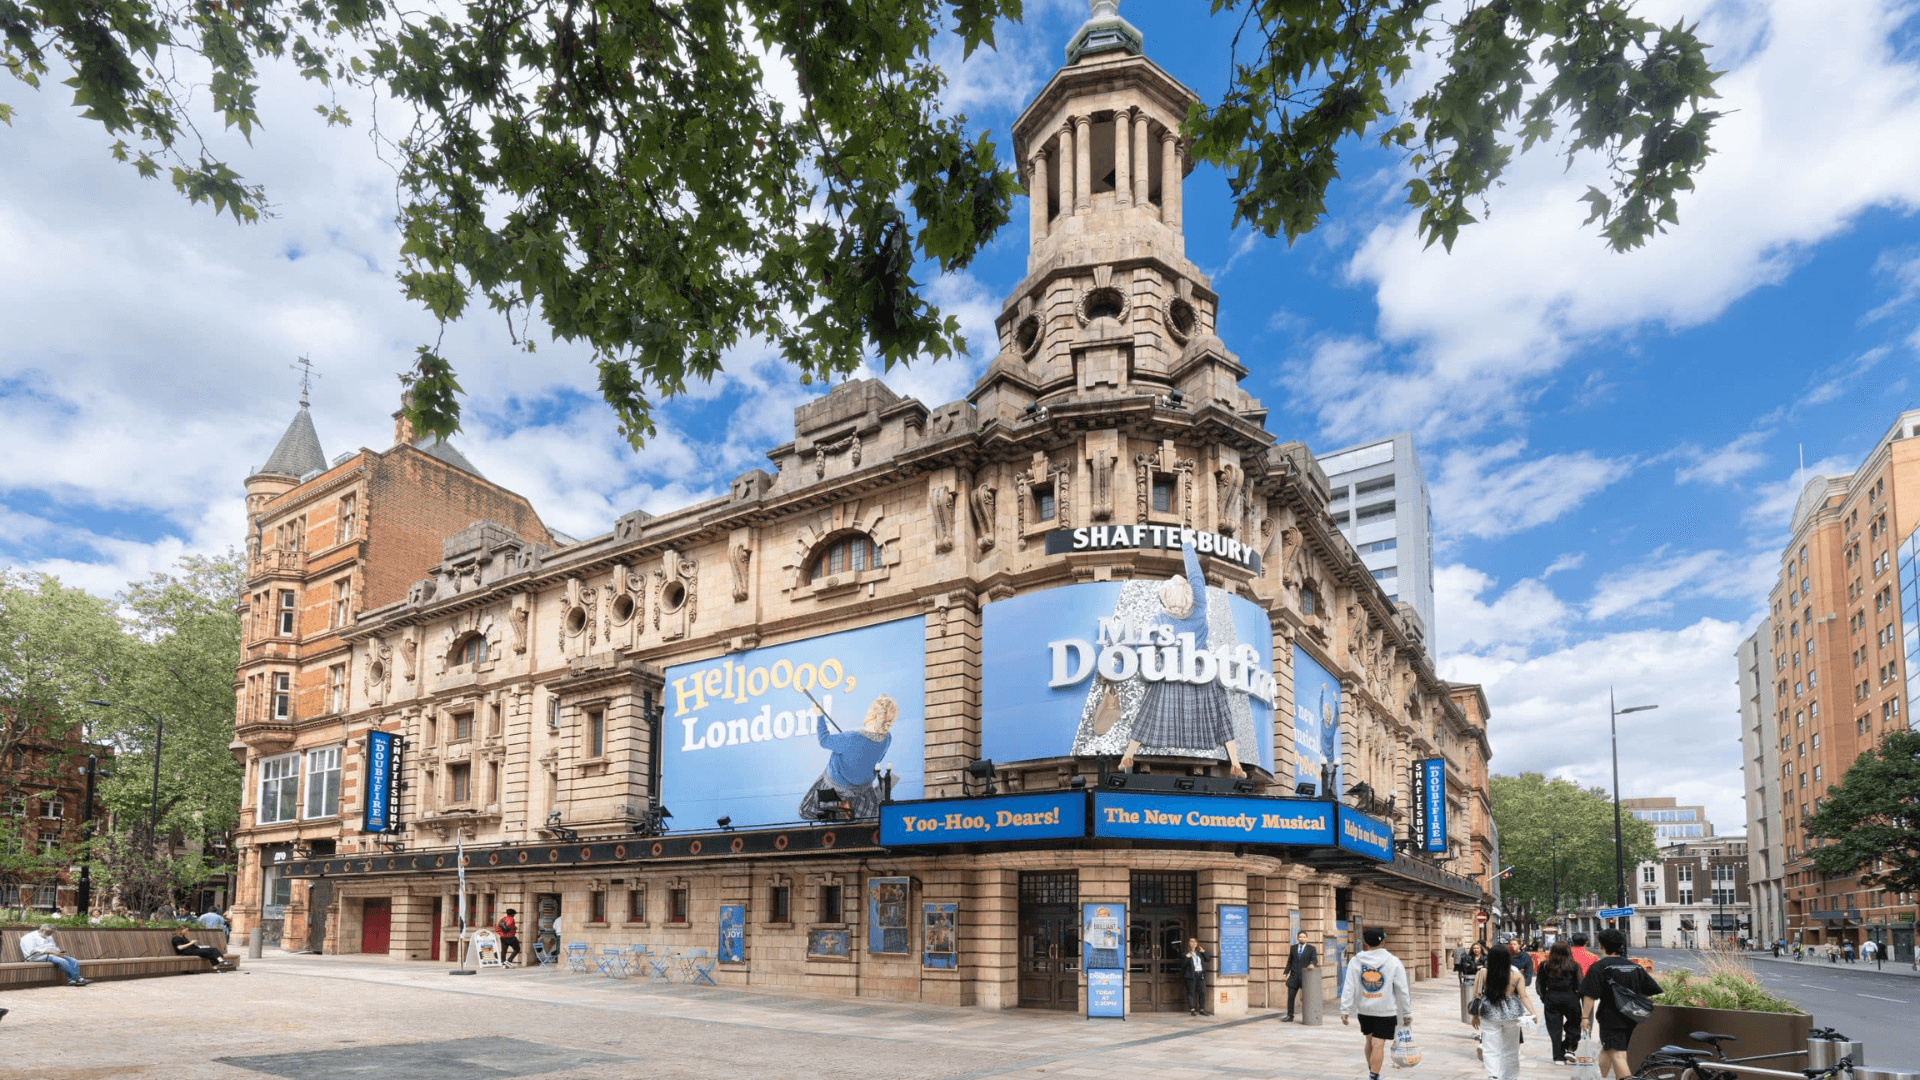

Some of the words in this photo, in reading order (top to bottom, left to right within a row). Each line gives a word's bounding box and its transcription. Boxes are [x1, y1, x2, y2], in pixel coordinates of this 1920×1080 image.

[1096, 617, 1182, 646] Mrs.
[672, 658, 857, 717] Helloooo,
[682, 694, 832, 752] London!
[1298, 704, 1315, 727] new
[372, 744, 385, 817] DOUBTFIRE
[390, 738, 401, 831] SHAFTESBURY
[903, 813, 991, 832] Yoo-Hoo,
[996, 807, 1060, 827] Dears!
[1104, 808, 1140, 823] The
[1144, 809, 1182, 825] New
[1187, 811, 1257, 831] Comedy
[1262, 813, 1326, 830] Musical
[1415, 763, 1424, 849] SHAFTESBURY
[1430, 770, 1441, 837] DOUBTFIRE
[1344, 819, 1358, 842] Help
[1358, 824, 1363, 840] is
[1363, 831, 1370, 842] on
[1370, 829, 1378, 845] the
[1378, 836, 1389, 852] way!
[727, 930, 743, 939] JOY!
